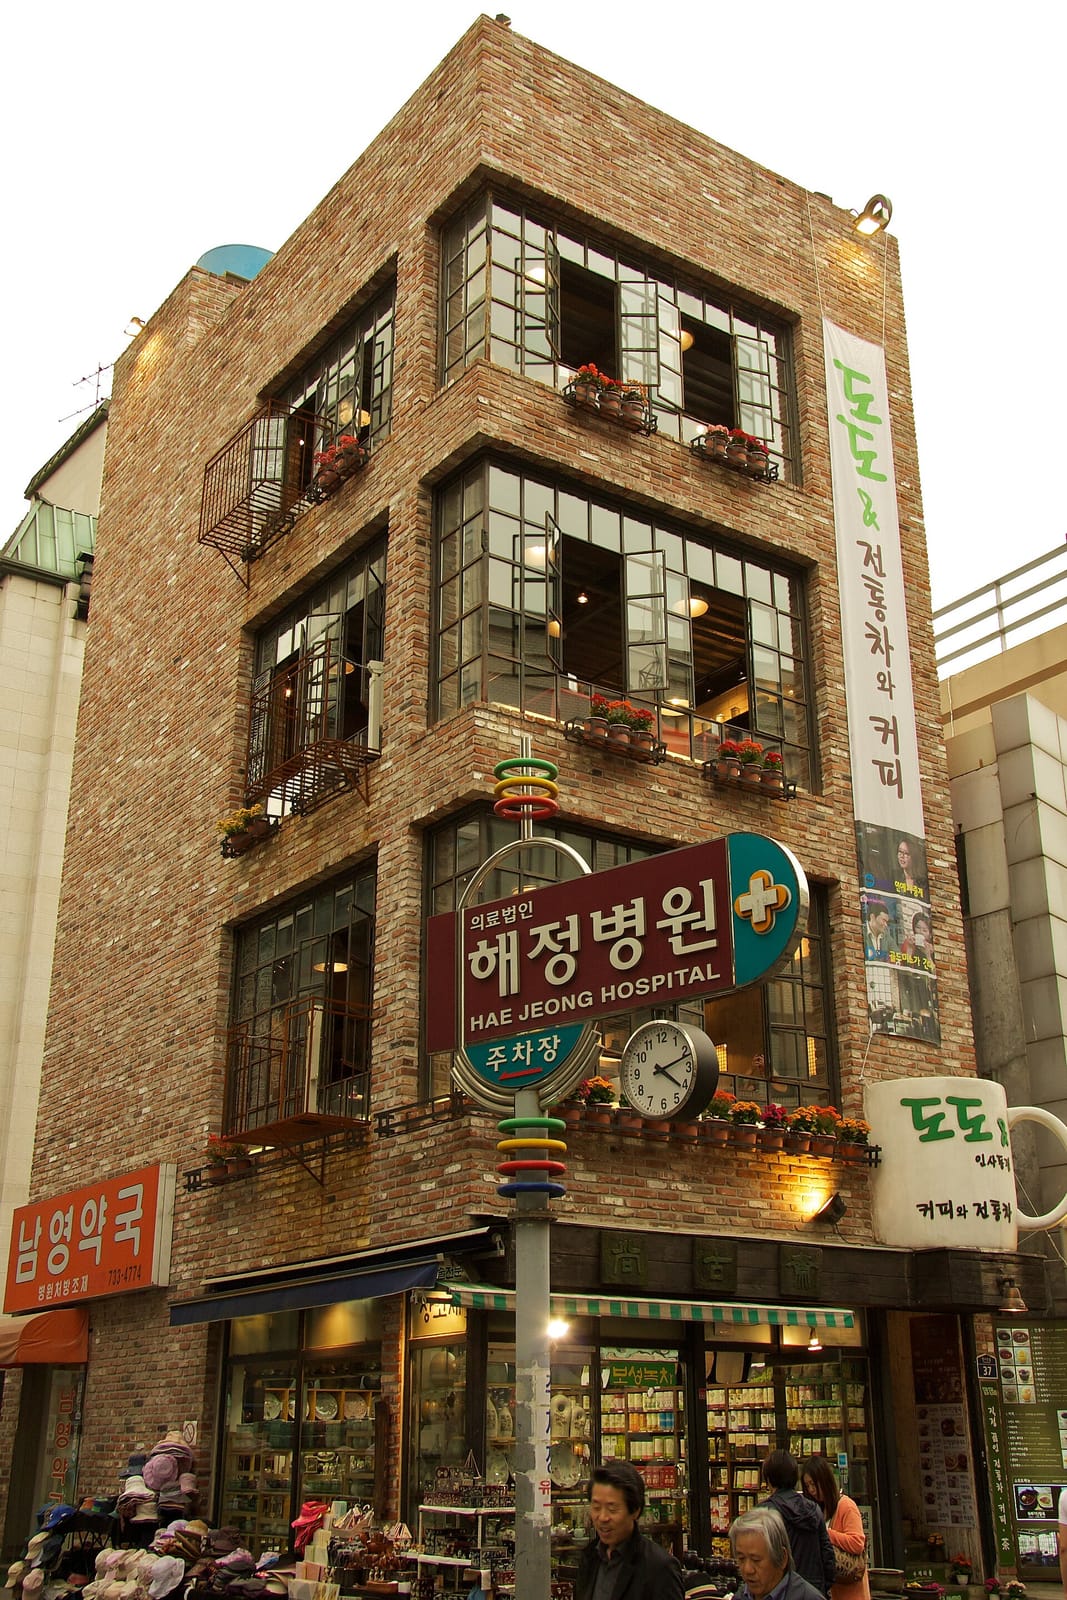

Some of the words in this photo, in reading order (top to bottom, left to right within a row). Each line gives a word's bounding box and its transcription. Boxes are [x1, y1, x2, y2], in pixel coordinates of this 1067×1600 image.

[868, 714, 904, 799] 커피
[469, 900, 534, 931] 의료법인
[467, 878, 718, 998] 해정병원
[470, 1008, 513, 1032] HAE
[518, 991, 594, 1022] JEONG
[601, 963, 721, 1003] HOSPITAL
[656, 1031, 668, 1044] 12
[673, 1035, 678, 1046] 1
[644, 1039, 654, 1050] 11
[681, 1045, 689, 1055] 2
[485, 1034, 561, 1072] 주차장
[636, 1052, 647, 1064] 10
[686, 1061, 692, 1073] 3
[634, 1068, 640, 1080] 9
[638, 1084, 644, 1095] 8
[681, 1079, 689, 1090] 4
[647, 1095, 653, 1107] 7
[674, 1092, 680, 1104] 5
[661, 1099, 667, 1110] 6
[916, 1200, 968, 1220] 커피와
[972, 1199, 1013, 1223] 전통차
[15, 1183, 144, 1284] 남영약국
[612, 1365, 673, 1385] 보성녹차
[982, 1366, 992, 1377] 37
